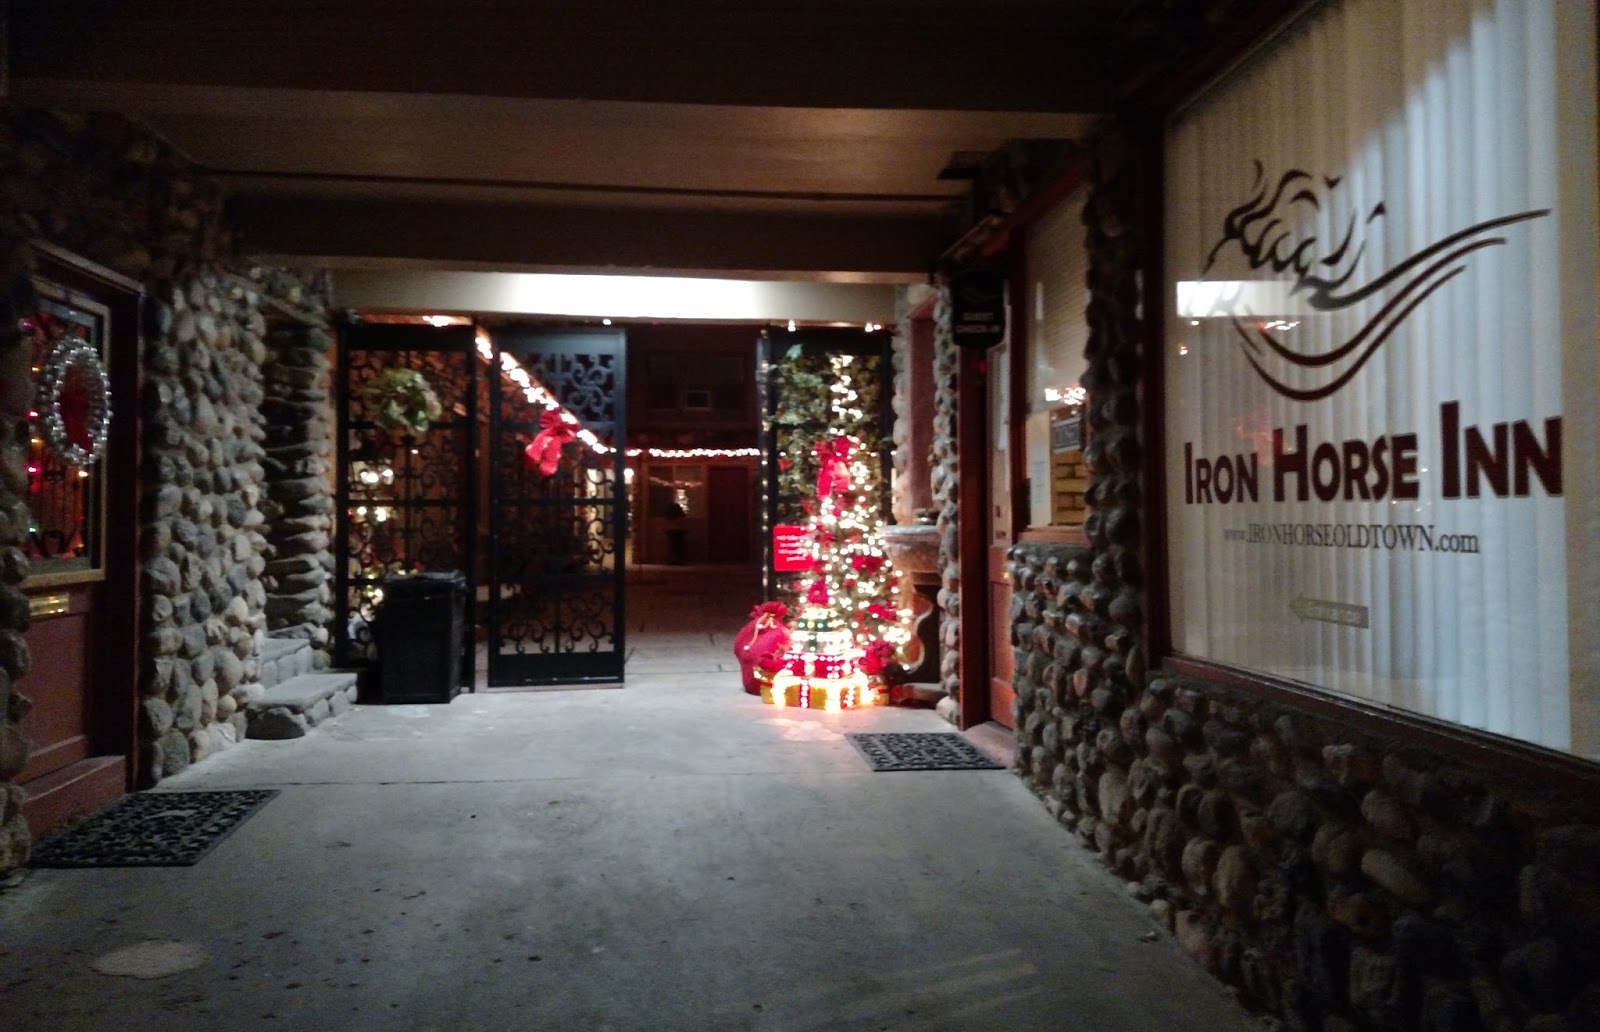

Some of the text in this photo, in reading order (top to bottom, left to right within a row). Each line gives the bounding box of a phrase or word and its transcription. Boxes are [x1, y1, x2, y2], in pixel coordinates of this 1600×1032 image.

[1184, 400, 1563, 504] IRON HORSE INN
